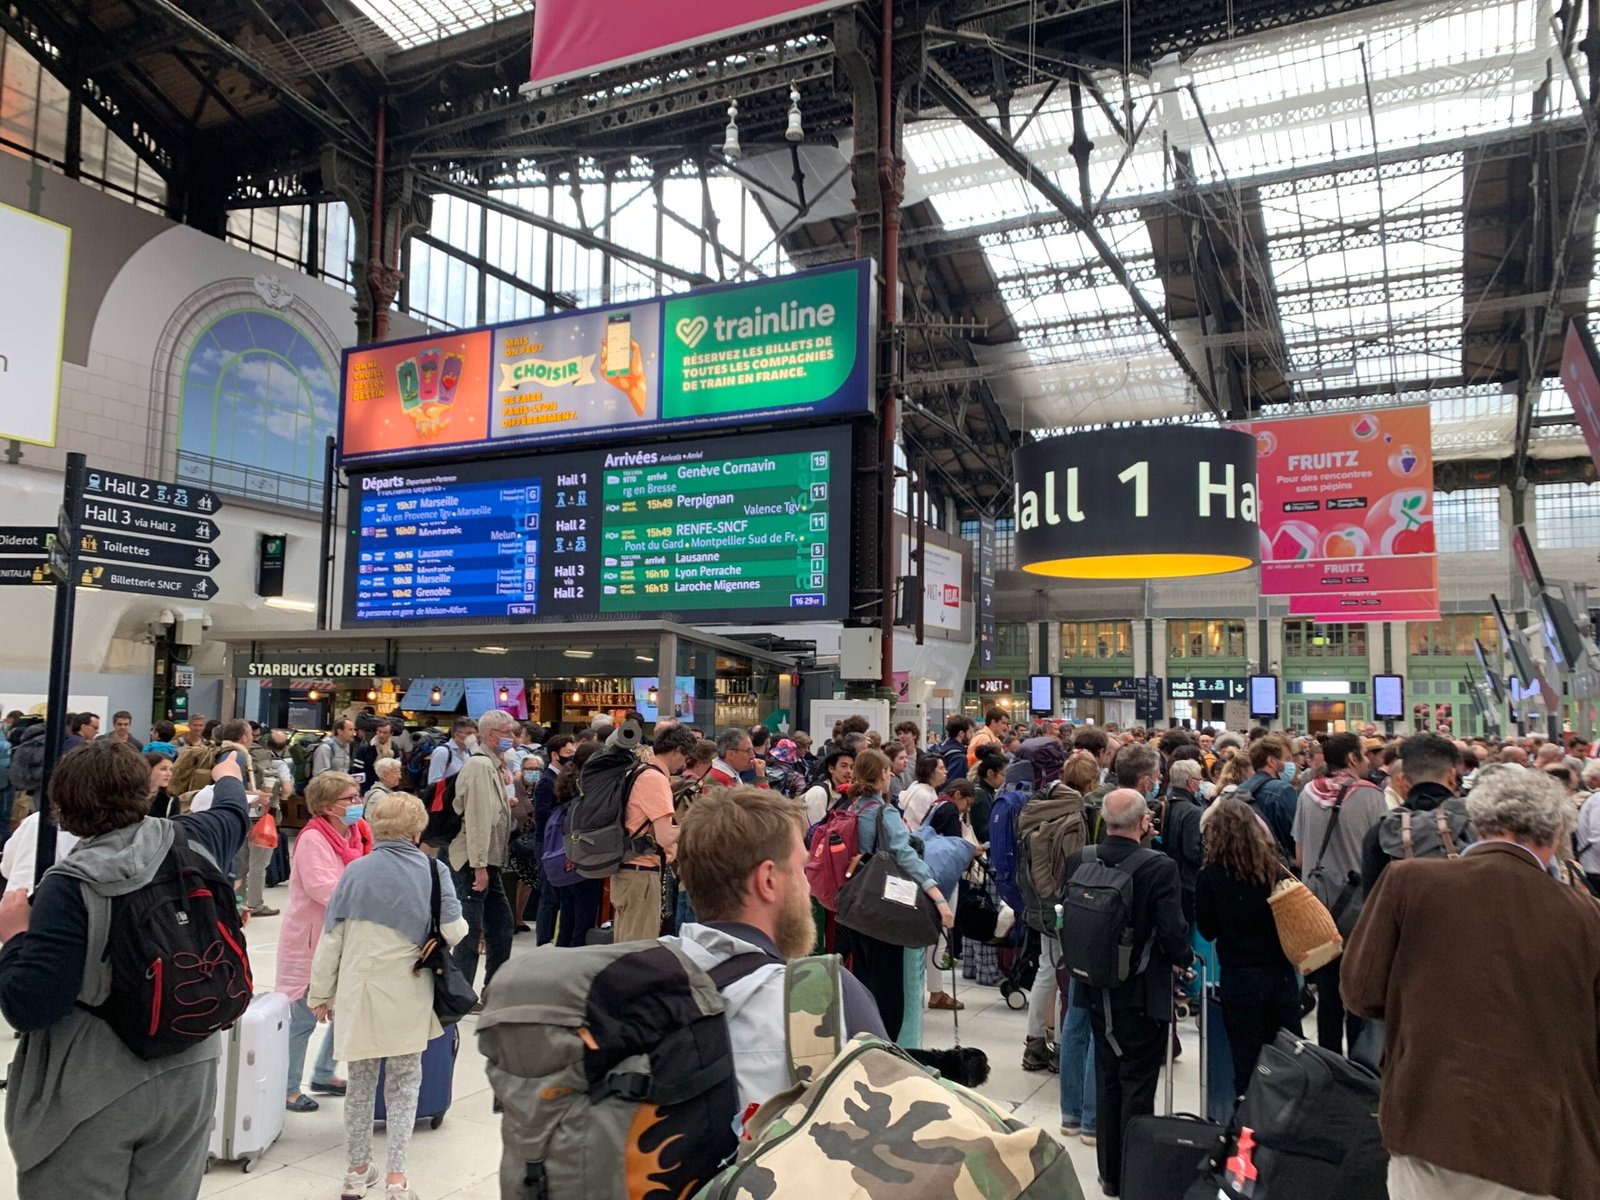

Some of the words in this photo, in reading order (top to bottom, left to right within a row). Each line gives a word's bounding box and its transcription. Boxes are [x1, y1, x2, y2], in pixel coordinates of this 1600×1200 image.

[714, 300, 836, 342] trainline
[504, 336, 529, 347] MAIS
[504, 347, 519, 357] ON
[683, 349, 741, 366] RÉSERVEZ
[742, 345, 763, 359] LES
[765, 339, 813, 355] BILLETS
[815, 336, 832, 347] DE
[683, 364, 728, 379] TOUTES
[730, 360, 750, 373] LES
[752, 349, 834, 369] COMPAGNIES
[513, 362, 579, 381] CHOISIR
[682, 380, 698, 392] DE
[700, 374, 736, 389] TRAIN
[737, 372, 753, 385] EN
[756, 366, 807, 382] FRANCE.
[517, 392, 543, 403] FAIRE
[502, 402, 557, 416] PARIS-LYON
[604, 451, 658, 467] Arrivées
[813, 456, 825, 466] 19
[1288, 450, 1359, 471] FRUITZ
[647, 471, 668, 481] arrivé
[677, 464, 720, 479] Genève
[722, 458, 776, 475] Cornavin
[362, 476, 404, 491] Départs
[557, 474, 578, 486] Hall
[580, 473, 587, 484] 1
[1277, 475, 1299, 484] Pour
[1301, 473, 1318, 482] des
[1321, 470, 1373, 481] rencontres
[104, 477, 137, 497] Hall
[140, 484, 150, 498] 2
[157, 490, 165, 501] 5
[174, 493, 188, 505] 23
[634, 486, 645, 495] en
[647, 483, 677, 494] Bresse
[813, 486, 825, 497] 11
[1117, 460, 1148, 517] 1
[1199, 461, 1258, 523] Ha
[1296, 484, 1318, 493] sans
[1320, 481, 1353, 492] pépins
[529, 490, 536, 499] G
[557, 496, 566, 505] A
[577, 494, 587, 504] N
[420, 495, 459, 509] Marseille
[646, 498, 673, 510] 15h49
[676, 493, 734, 509] Perpignan
[381, 512, 393, 522] Aix
[404, 510, 438, 521] Provence
[440, 508, 451, 520] Tgv
[457, 505, 492, 517] Marseille
[743, 503, 782, 516] Valence
[783, 501, 801, 515] Tgv
[85, 504, 117, 523] Hall
[121, 511, 131, 524] 3
[134, 518, 148, 528] via
[150, 521, 169, 531] Hall
[170, 523, 176, 532] 2
[528, 517, 535, 526] J
[812, 516, 824, 527] 11
[556, 520, 577, 531] Hall
[578, 519, 586, 530] 2
[646, 527, 672, 538] 15h49
[676, 520, 748, 535] RENFE-SNCF
[0, 535, 38, 546] Diderot
[491, 530, 516, 540] Melun
[625, 541, 646, 551] Pont
[648, 540, 659, 550] du
[662, 538, 684, 549] Gard
[691, 535, 746, 548] Montpellier
[748, 533, 767, 544] Sud
[769, 532, 782, 543] de
[784, 531, 798, 542] Fr.
[103, 541, 150, 556] Toilettes
[556, 541, 563, 550] 5
[575, 540, 586, 550] 23
[418, 549, 453, 559] Lausanne
[645, 556, 666, 565] arrivé
[675, 552, 719, 563] Lausanne
[554, 565, 576, 577] Hall
[577, 565, 584, 576] 3
[645, 568, 669, 578] 16h10
[675, 567, 697, 579] Lyon
[700, 564, 742, 576] Perrache
[1324, 563, 1365, 573] FRUITZ
[111, 575, 156, 588] Billetterie
[157, 580, 182, 591] SNCF
[417, 573, 451, 584] Marseille
[416, 586, 451, 598] Grenoble
[644, 583, 669, 593] 16h13
[675, 580, 712, 592] Laroche
[713, 579, 760, 593] Migennes
[554, 588, 575, 599] Hall
[577, 587, 584, 598] 2
[249, 663, 323, 676] STARBUCKS
[326, 663, 375, 676] COFFEE
